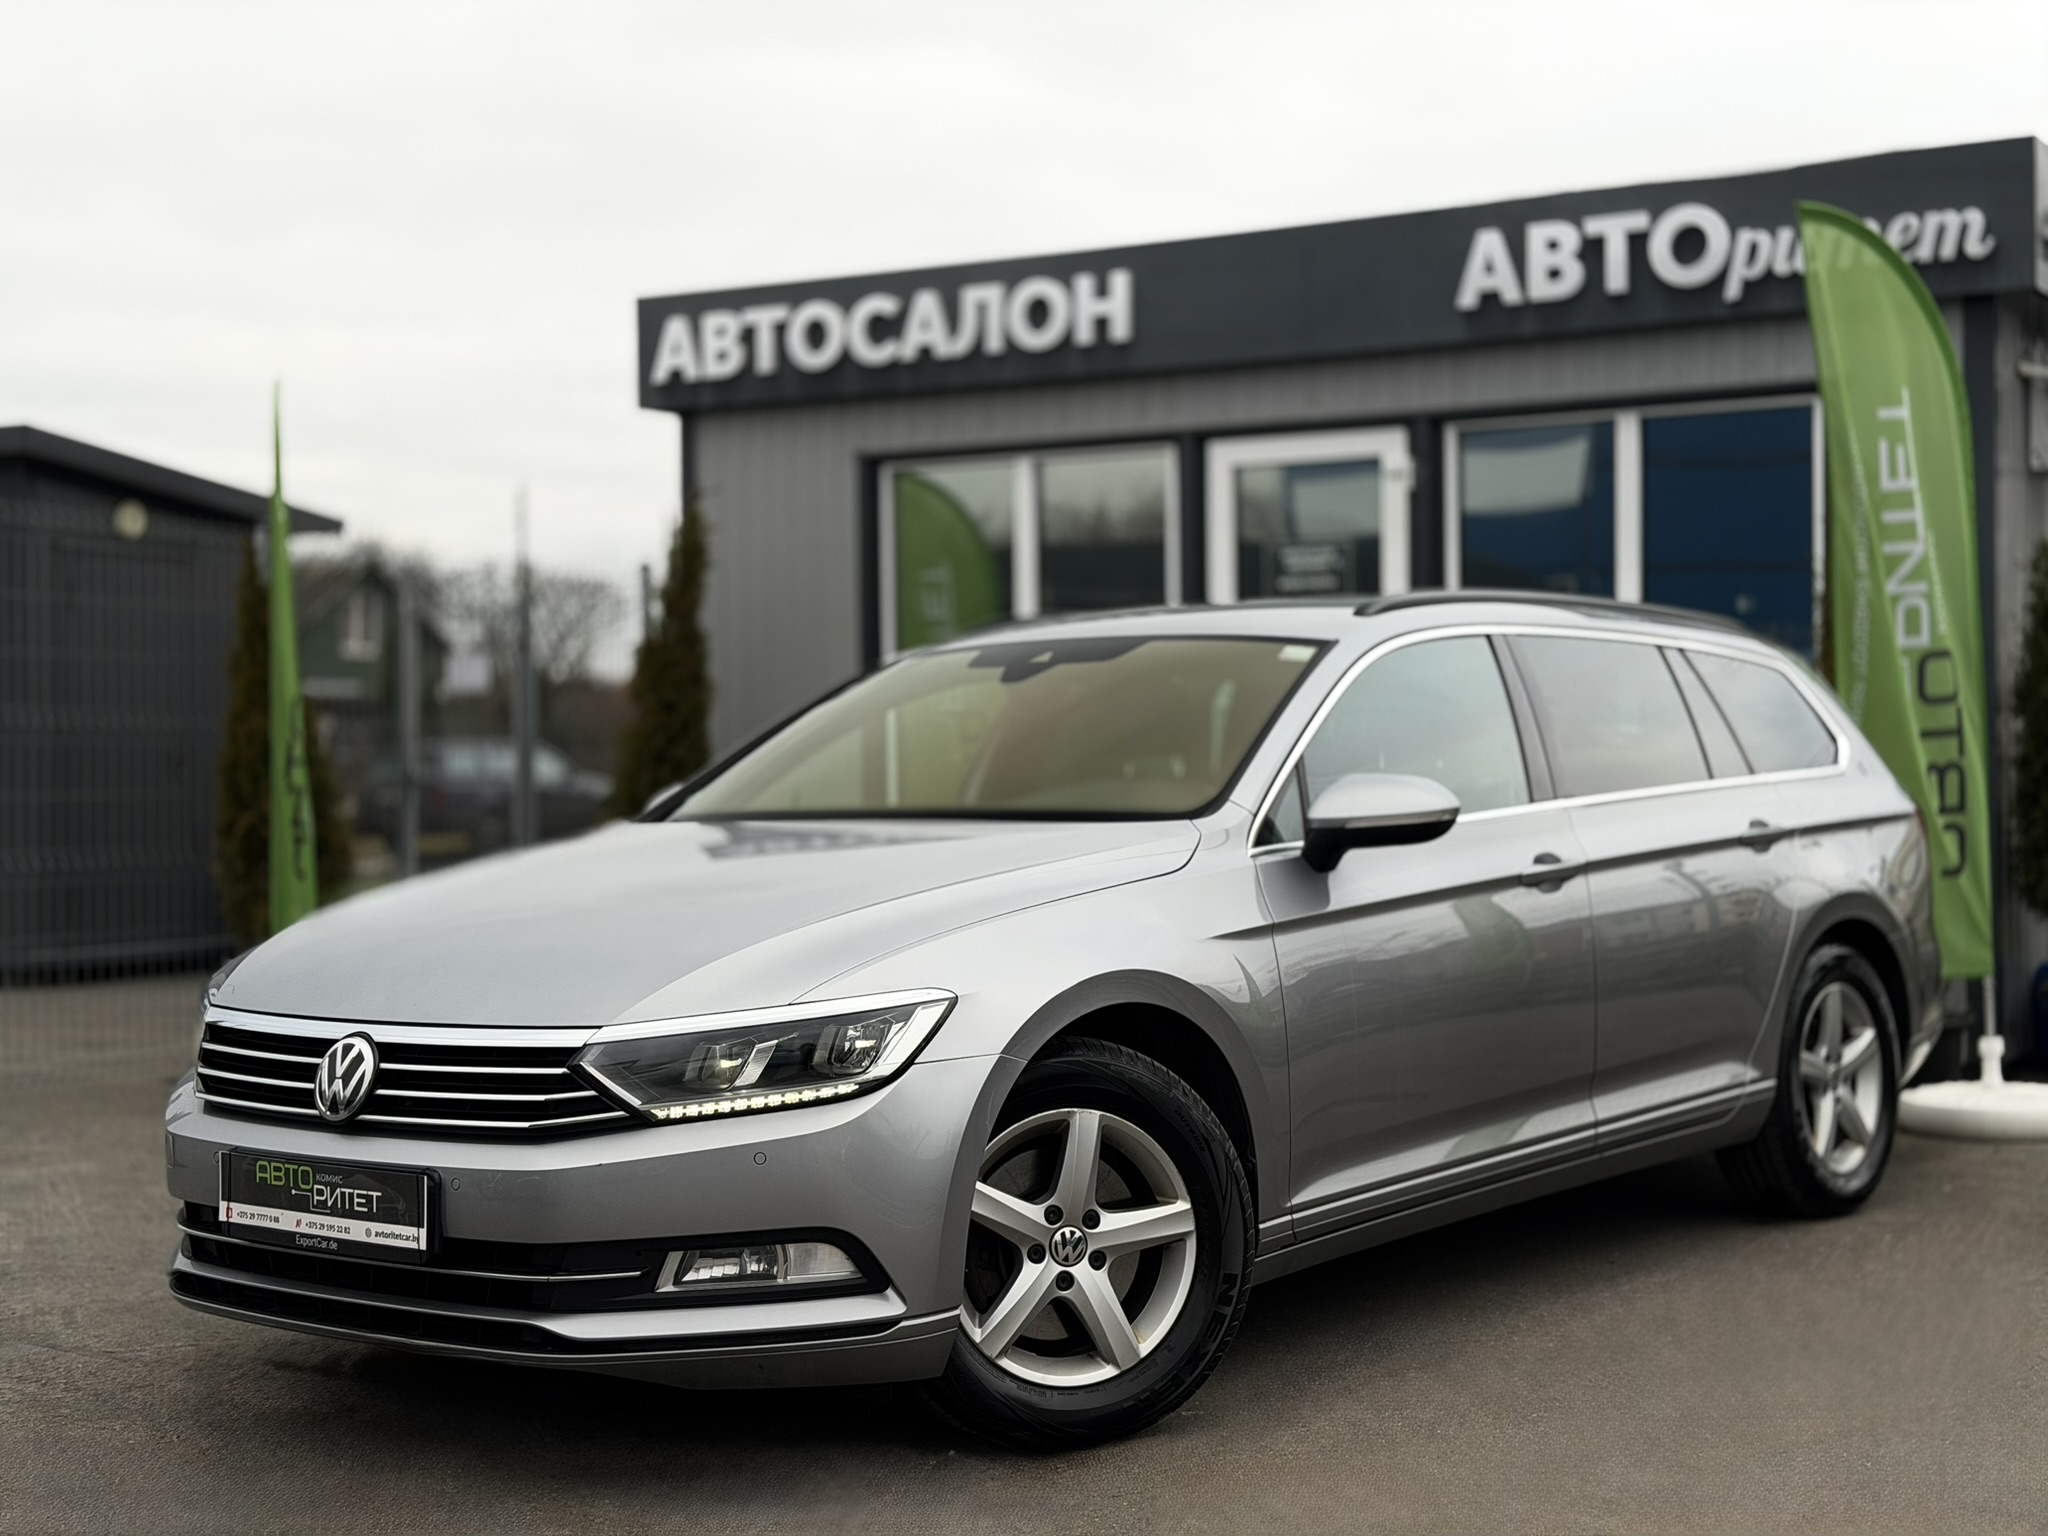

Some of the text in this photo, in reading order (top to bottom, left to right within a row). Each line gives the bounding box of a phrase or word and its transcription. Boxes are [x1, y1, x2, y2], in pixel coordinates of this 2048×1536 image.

[1455, 201, 1995, 311] АВТОриет
[649, 267, 1134, 386] АВТОСАЛОН
[256, 1160, 313, 1190] АВТО
[315, 1173, 343, 1184] КОМИС
[313, 1184, 382, 1213] РИТЕТ
[296, 1235, 338, 1250] ExportCar.de
